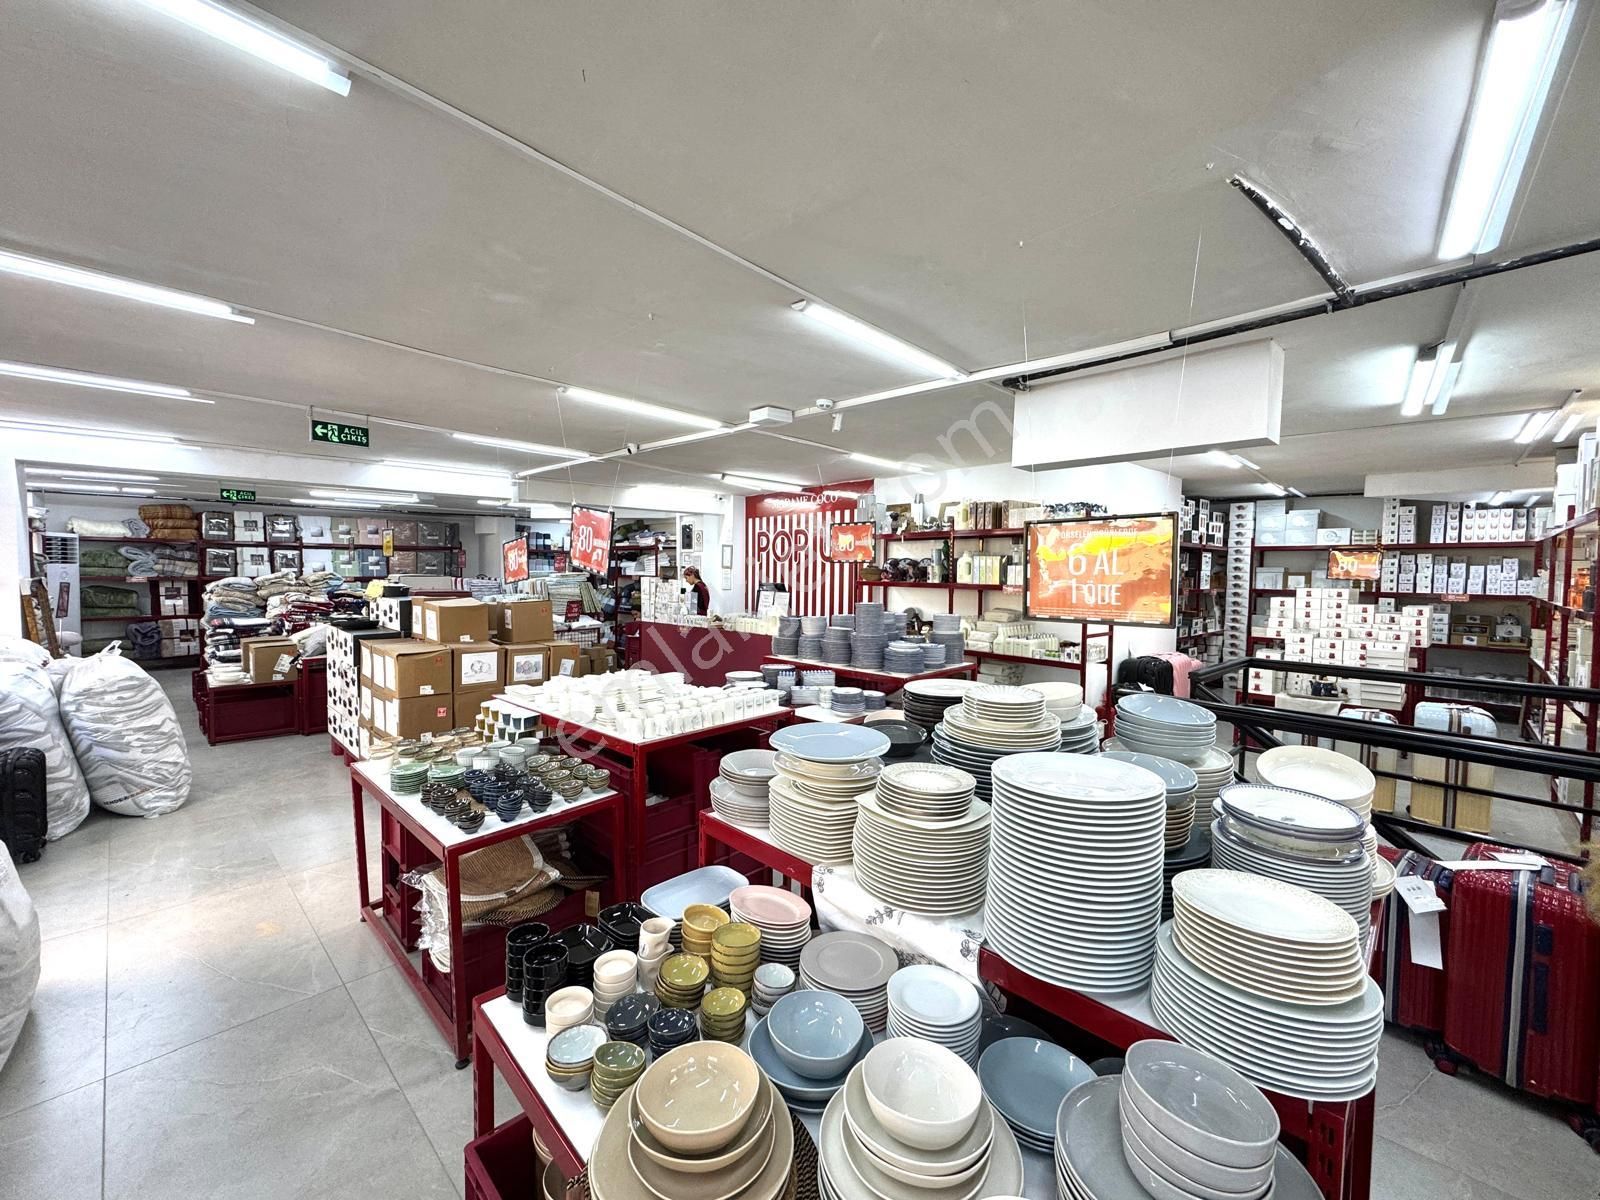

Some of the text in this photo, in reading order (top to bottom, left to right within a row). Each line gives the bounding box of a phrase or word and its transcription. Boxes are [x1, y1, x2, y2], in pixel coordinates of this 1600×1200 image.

[810, 493, 839, 505] COCO
[757, 528, 809, 564] POP
[1068, 542, 1125, 576] 6 AL
